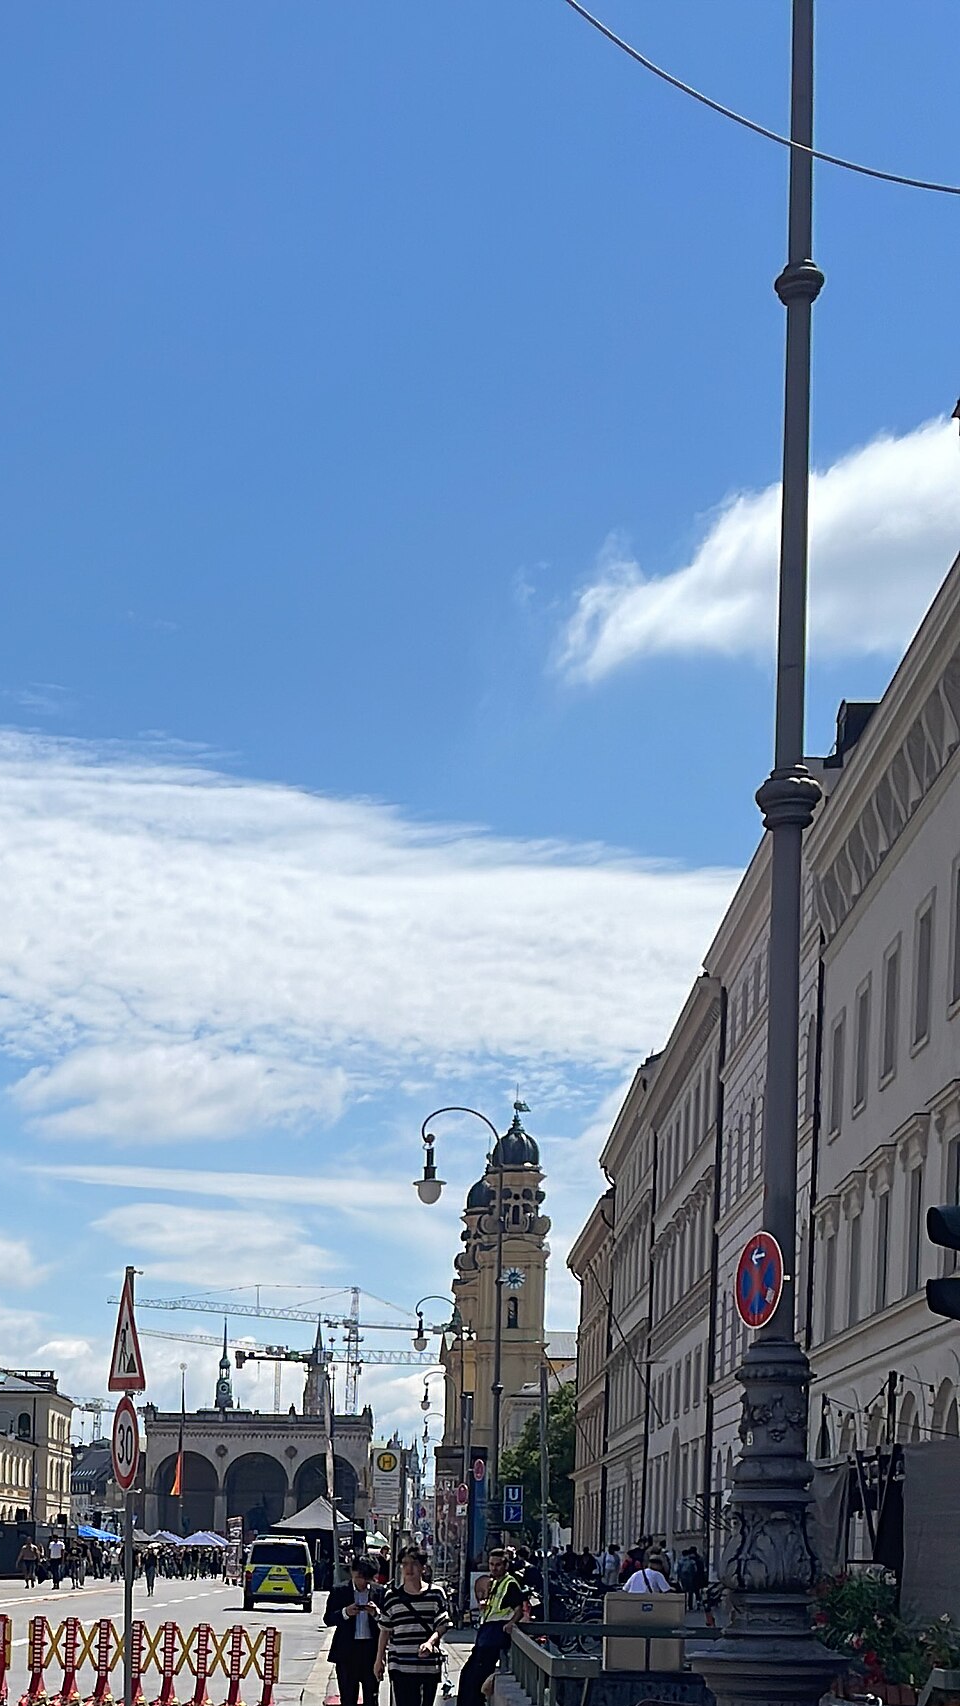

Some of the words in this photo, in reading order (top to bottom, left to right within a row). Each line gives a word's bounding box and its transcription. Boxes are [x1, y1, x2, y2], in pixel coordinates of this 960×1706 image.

[117, 1424, 133, 1466] 30
[382, 1456, 392, 1468] H
[508, 1488, 519, 1500] U
